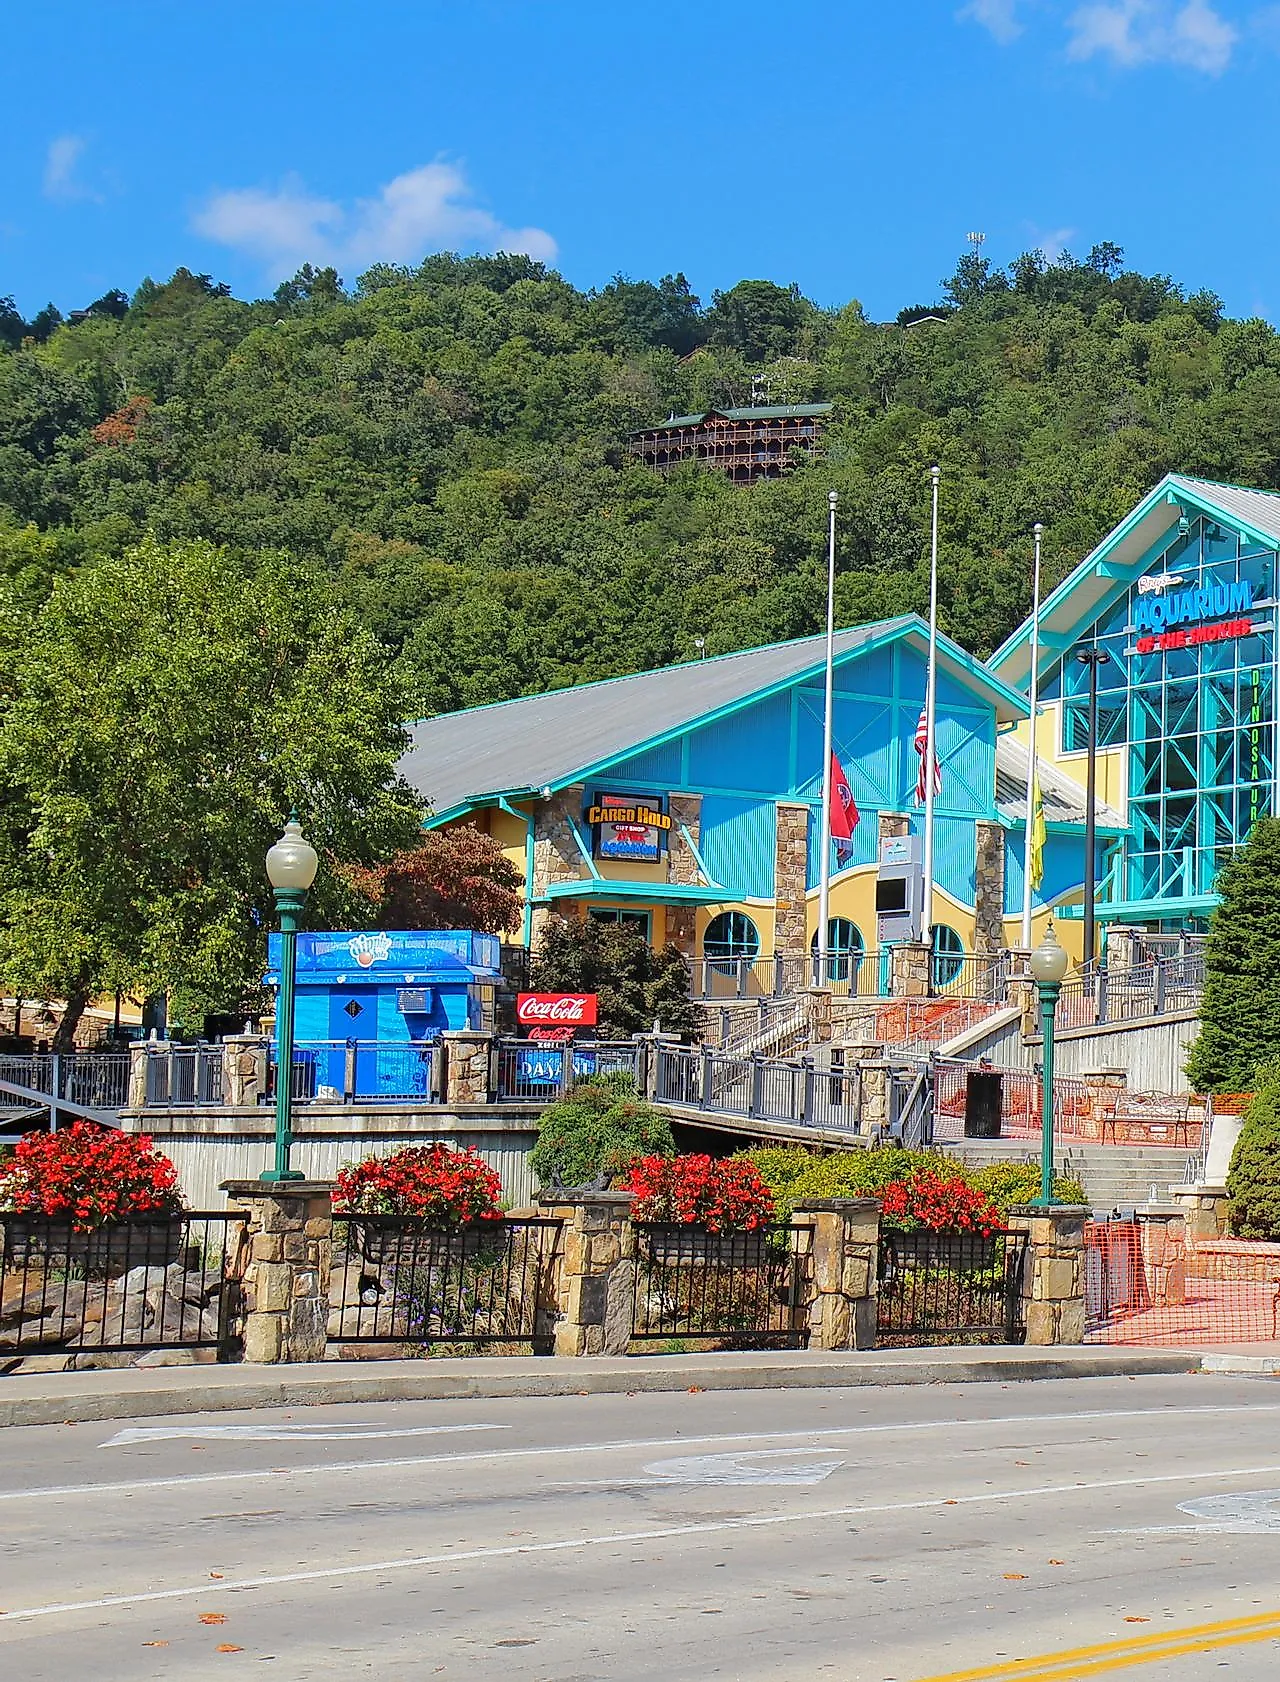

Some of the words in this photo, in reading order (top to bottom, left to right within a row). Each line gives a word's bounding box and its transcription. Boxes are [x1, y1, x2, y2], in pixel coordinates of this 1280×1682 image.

[1135, 581, 1252, 633] AQUARIUM
[1136, 637, 1155, 653] OF
[1159, 630, 1186, 649] THE
[1190, 618, 1251, 644] SMOKIES
[519, 997, 588, 1020] Coca-Cola
